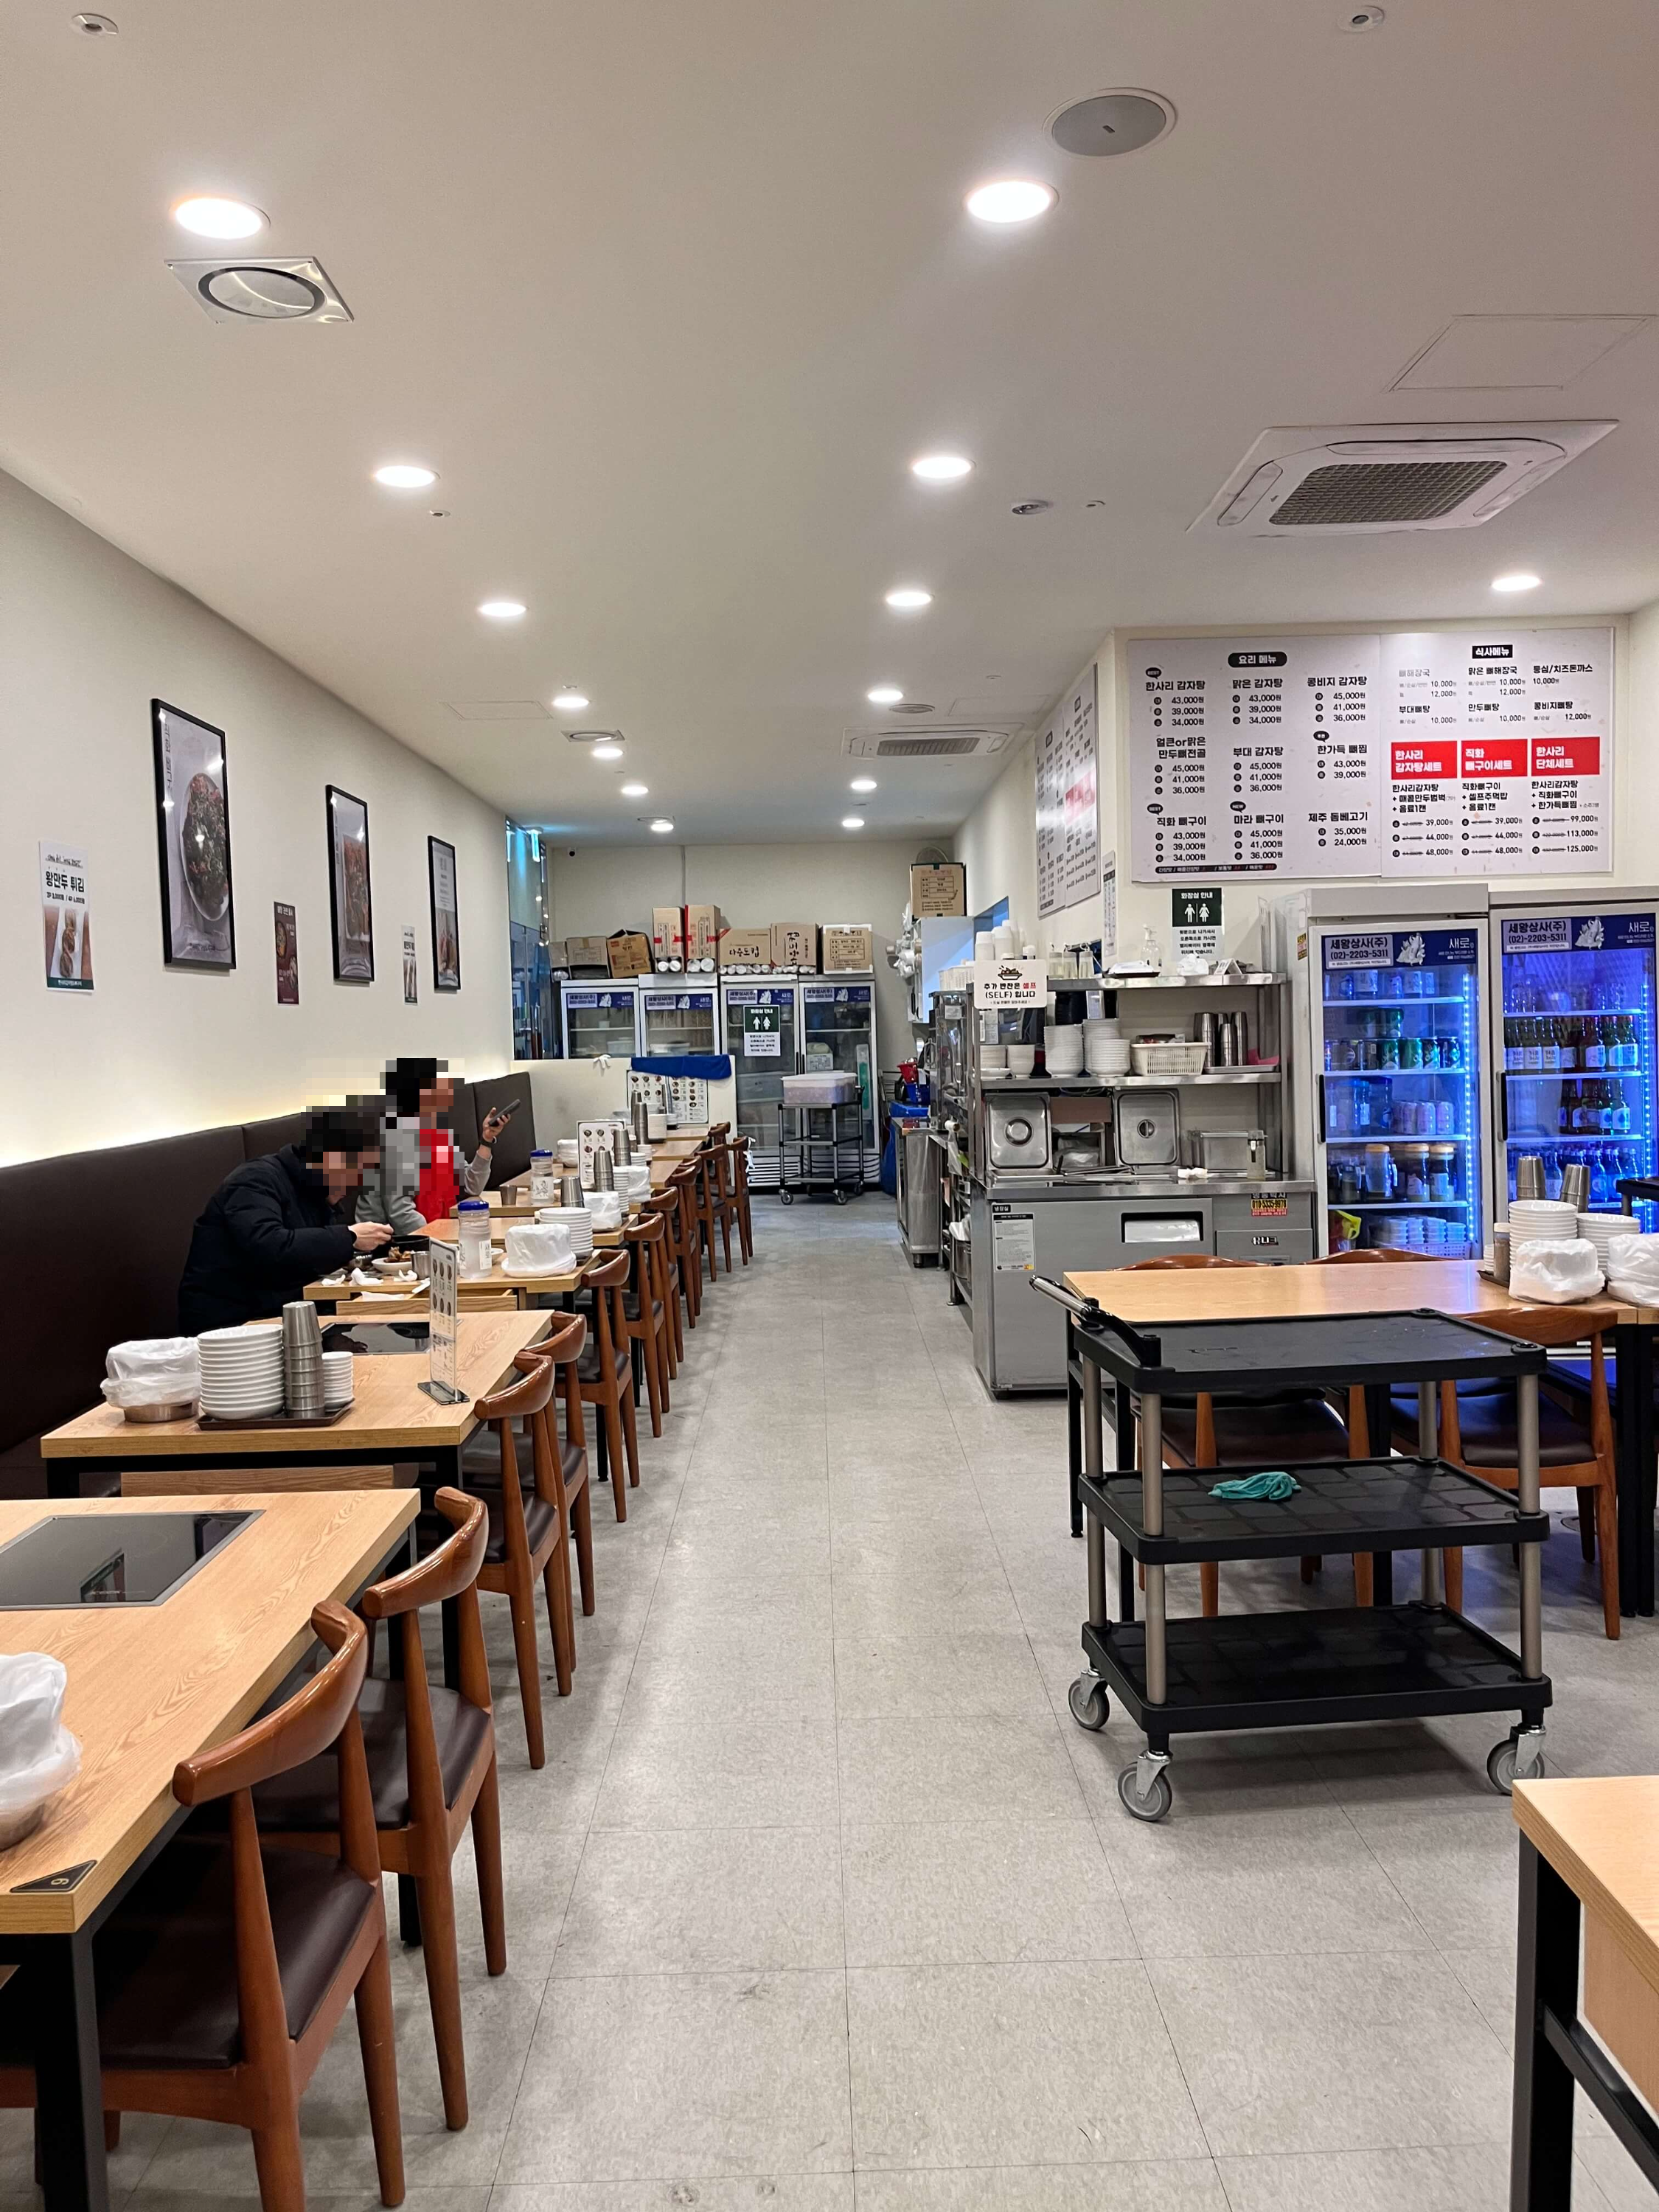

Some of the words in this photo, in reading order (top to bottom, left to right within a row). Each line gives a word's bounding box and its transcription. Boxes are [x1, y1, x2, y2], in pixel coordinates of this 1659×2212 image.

[1475, 647, 1509, 657] 식사메뉴
[1239, 655, 1256, 664] 요리
[1259, 655, 1277, 664] 메뉴
[1469, 667, 1484, 675] 맑은
[1146, 681, 1174, 691] 한사리
[1177, 681, 1205, 690] 감자탕
[1233, 679, 1251, 689] 맑은
[1255, 678, 1283, 689] 감자탕
[1307, 677, 1335, 687] 콩비지
[1339, 676, 1367, 686] 감자탕
[1172, 696, 1205, 705] 43,000원
[1249, 695, 1281, 703] 43,000원
[1249, 706, 1281, 714] 39,000원
[1172, 718, 1205, 727] 34,000원
[1249, 717, 1281, 725] 34,000원
[1333, 714, 1366, 722] 36,000원
[1156, 737, 1206, 748] 얼큰or맑은
[1234, 748, 1252, 757] 부대
[1255, 747, 1283, 757] 감자탕
[1317, 745, 1345, 755] 한가득
[1465, 748, 1485, 758] 직화
[1536, 746, 1565, 757] 한사리
[1395, 750, 1423, 761] 한사리
[1250, 762, 1281, 771] 45,000원
[1334, 760, 1366, 768] 43,000원
[1395, 762, 1442, 773] 감자탕세트
[1536, 758, 1573, 769] 단체세트
[1172, 765, 1205, 773] 45,000원
[1250, 773, 1281, 782] 41,000원
[1250, 785, 1281, 793] 36,000원
[1392, 784, 1439, 792] 한사리감자탕
[1531, 780, 1578, 789] 한사리감자탕
[1172, 786, 1205, 795] 36,000원
[1156, 817, 1175, 827] 직화
[1234, 815, 1253, 824] 마라
[1308, 813, 1327, 823] 제주
[1495, 817, 1523, 825] 39,000원
[1251, 830, 1283, 838] 45,000원
[1335, 827, 1367, 835] 35,000원
[1173, 832, 1205, 841] 43,000원
[1251, 841, 1283, 849] 41,000원
[1335, 838, 1367, 846] 24,000원
[1426, 849, 1453, 857] 48,000원
[1495, 846, 1523, 855] 48,000원
[1567, 845, 1599, 853] 125,000원
[1173, 854, 1206, 862] 34,000원
[1251, 852, 1283, 860] 36,000원
[46, 871, 68, 890] 왕만두
[71, 876, 84, 892] 튀김
[1509, 920, 1566, 933] 세왕상사(주)
[1628, 922, 1649, 933] 새로
[1331, 936, 1388, 950] 세왕상사(주)
[1449, 938, 1470, 948] 새로
[1509, 933, 1566, 944] (02)-2203-5311
[1331, 950, 1388, 960] (02)-2203-5311
